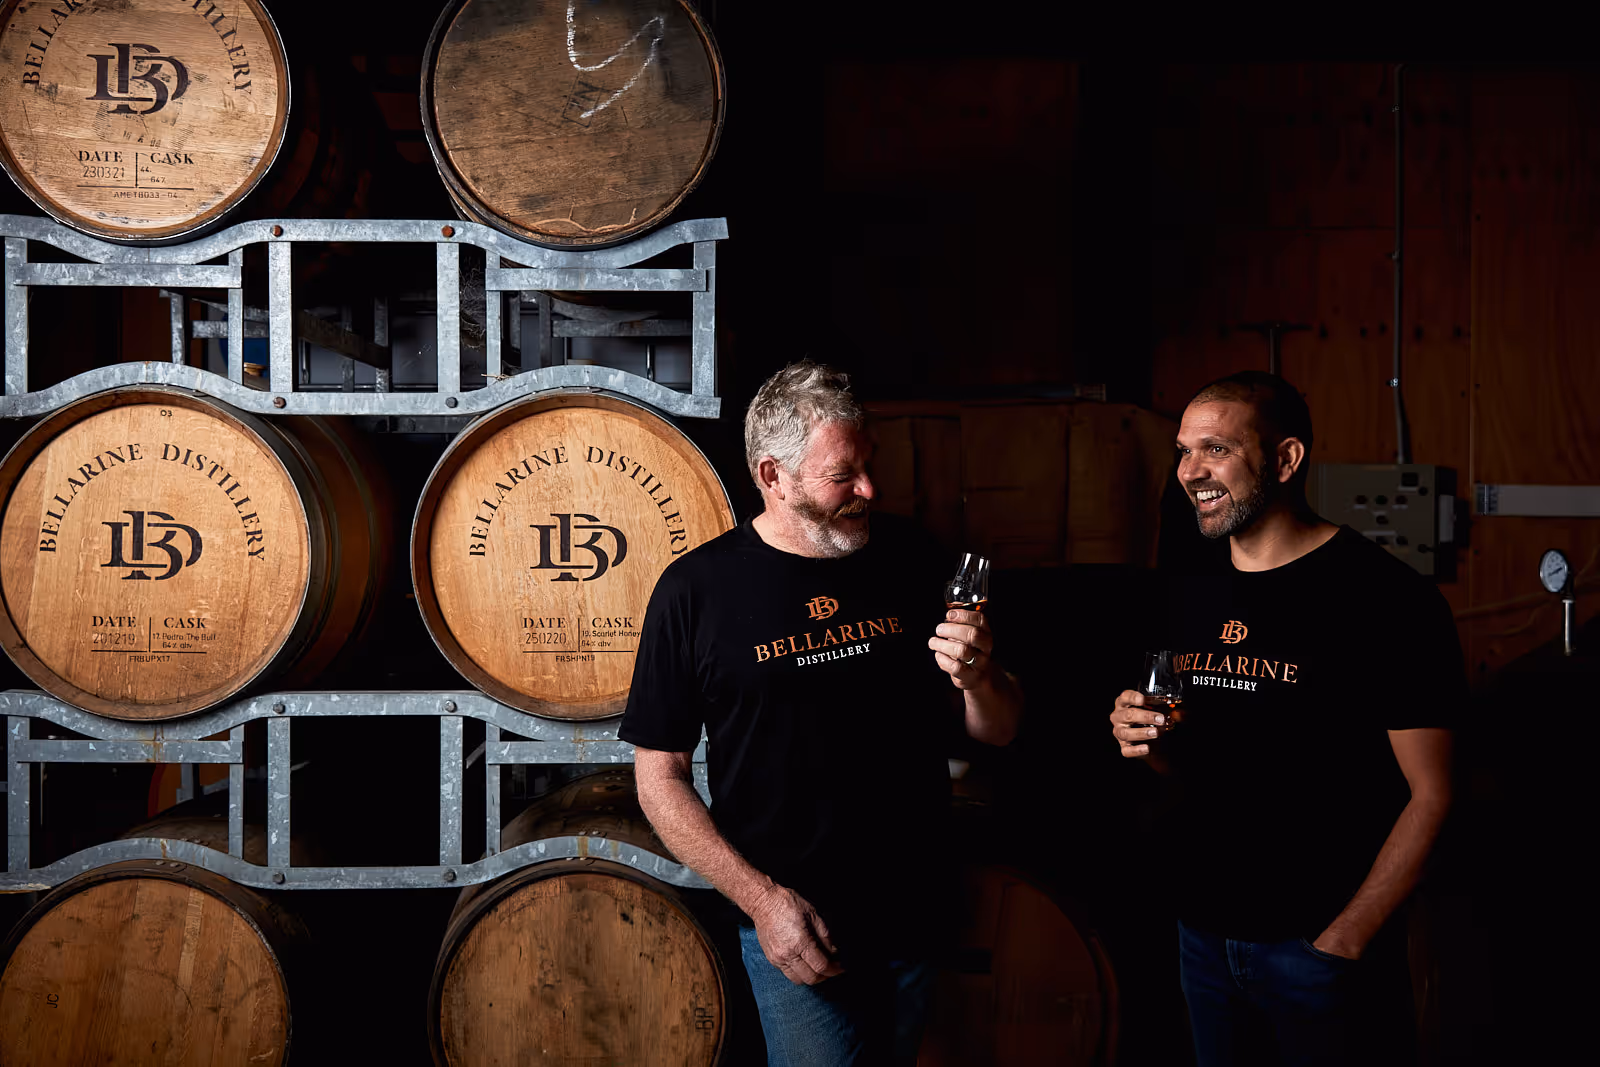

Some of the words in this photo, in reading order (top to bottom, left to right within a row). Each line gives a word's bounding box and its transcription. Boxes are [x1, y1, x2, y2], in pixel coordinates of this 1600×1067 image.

[78, 150, 123, 163] DATE
[150, 152, 194, 165] CASK
[82, 165, 125, 179] 230321
[39, 442, 144, 553] BELLARINE
[160, 442, 265, 562] DISTILLERY
[469, 446, 569, 558] BELLARINE
[91, 615, 137, 628] DATE
[163, 616, 208, 629] CASK
[522, 616, 567, 629] DATE
[591, 616, 635, 629] CASK
[92, 632, 137, 646] 201219
[162, 632, 185, 641] Pedro
[187, 632, 200, 641] The
[201, 633, 217, 642] Bull
[525, 632, 567, 645] 250220
[592, 629, 616, 638] Scarlet
[618, 629, 641, 639] Honey
[753, 617, 903, 663] BELLARINE
[796, 642, 871, 667] DISTILLERY
[1173, 652, 1298, 684] BELLARINE
[1192, 675, 1258, 692] DISTILLERY
